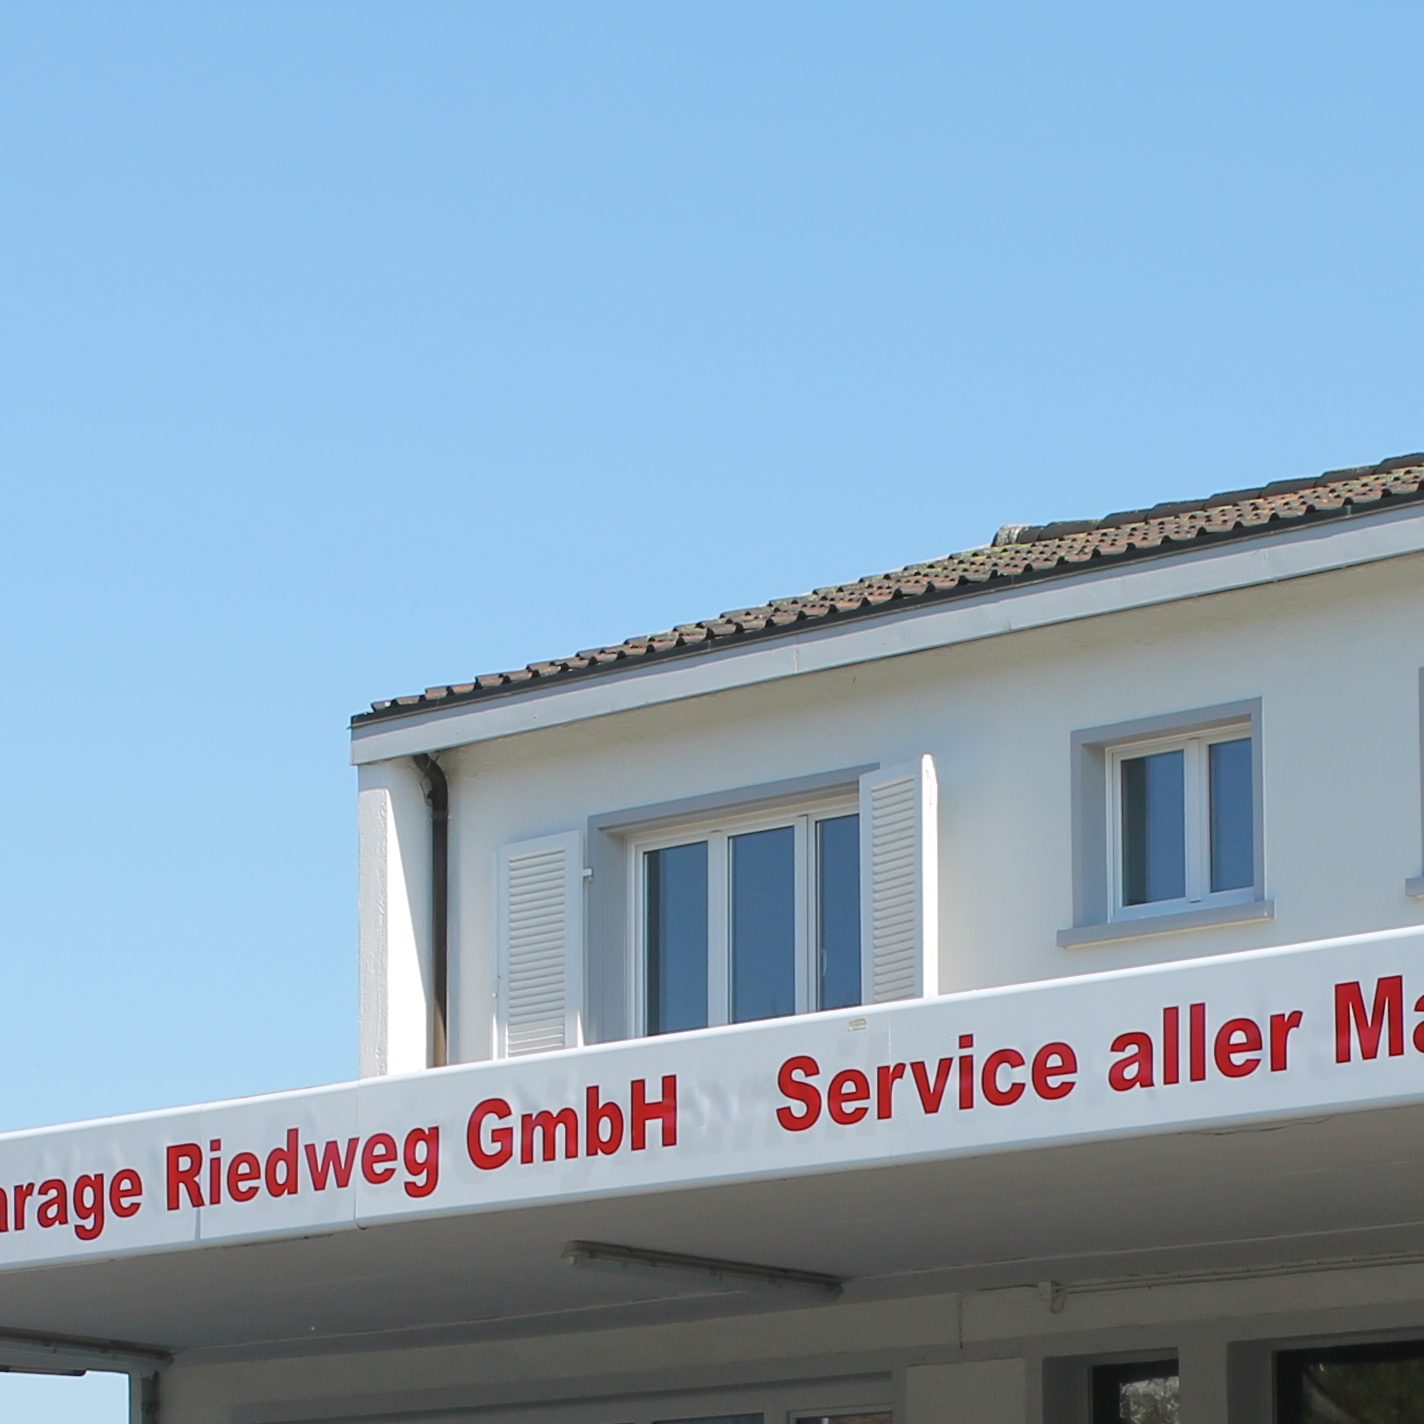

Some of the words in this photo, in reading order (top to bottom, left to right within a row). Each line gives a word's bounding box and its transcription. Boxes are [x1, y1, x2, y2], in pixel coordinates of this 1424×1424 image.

[776, 1033, 1078, 1133] Service
[1108, 1002, 1303, 1093] aller
[166, 1127, 440, 1199] Riedweg
[466, 1074, 678, 1171] GmbH
